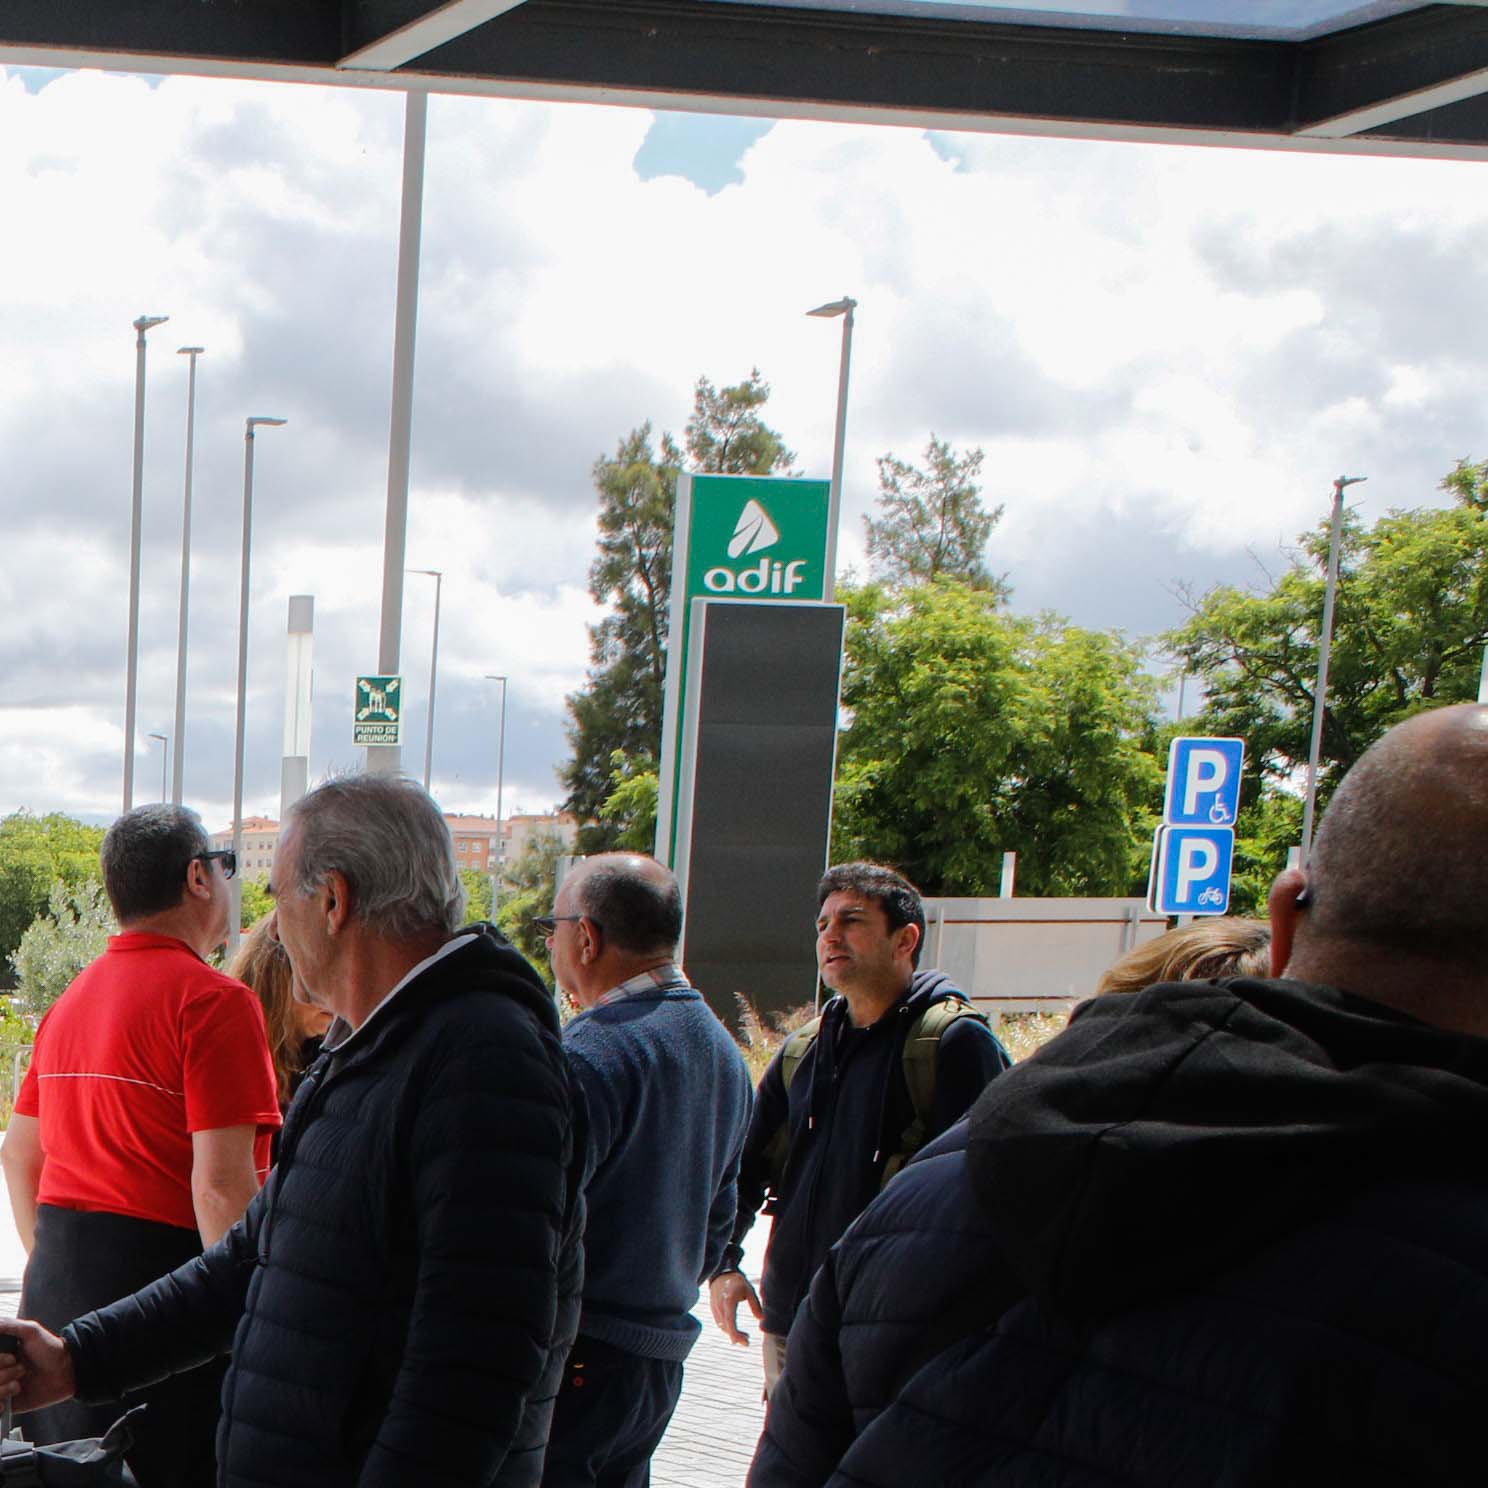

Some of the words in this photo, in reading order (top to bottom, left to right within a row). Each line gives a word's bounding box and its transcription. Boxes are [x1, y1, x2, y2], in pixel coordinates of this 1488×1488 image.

[704, 558, 807, 593] adif
[355, 726, 384, 734] PUNTO
[385, 726, 397, 734] DE
[1183, 750, 1227, 815] P
[1175, 838, 1218, 903] P
